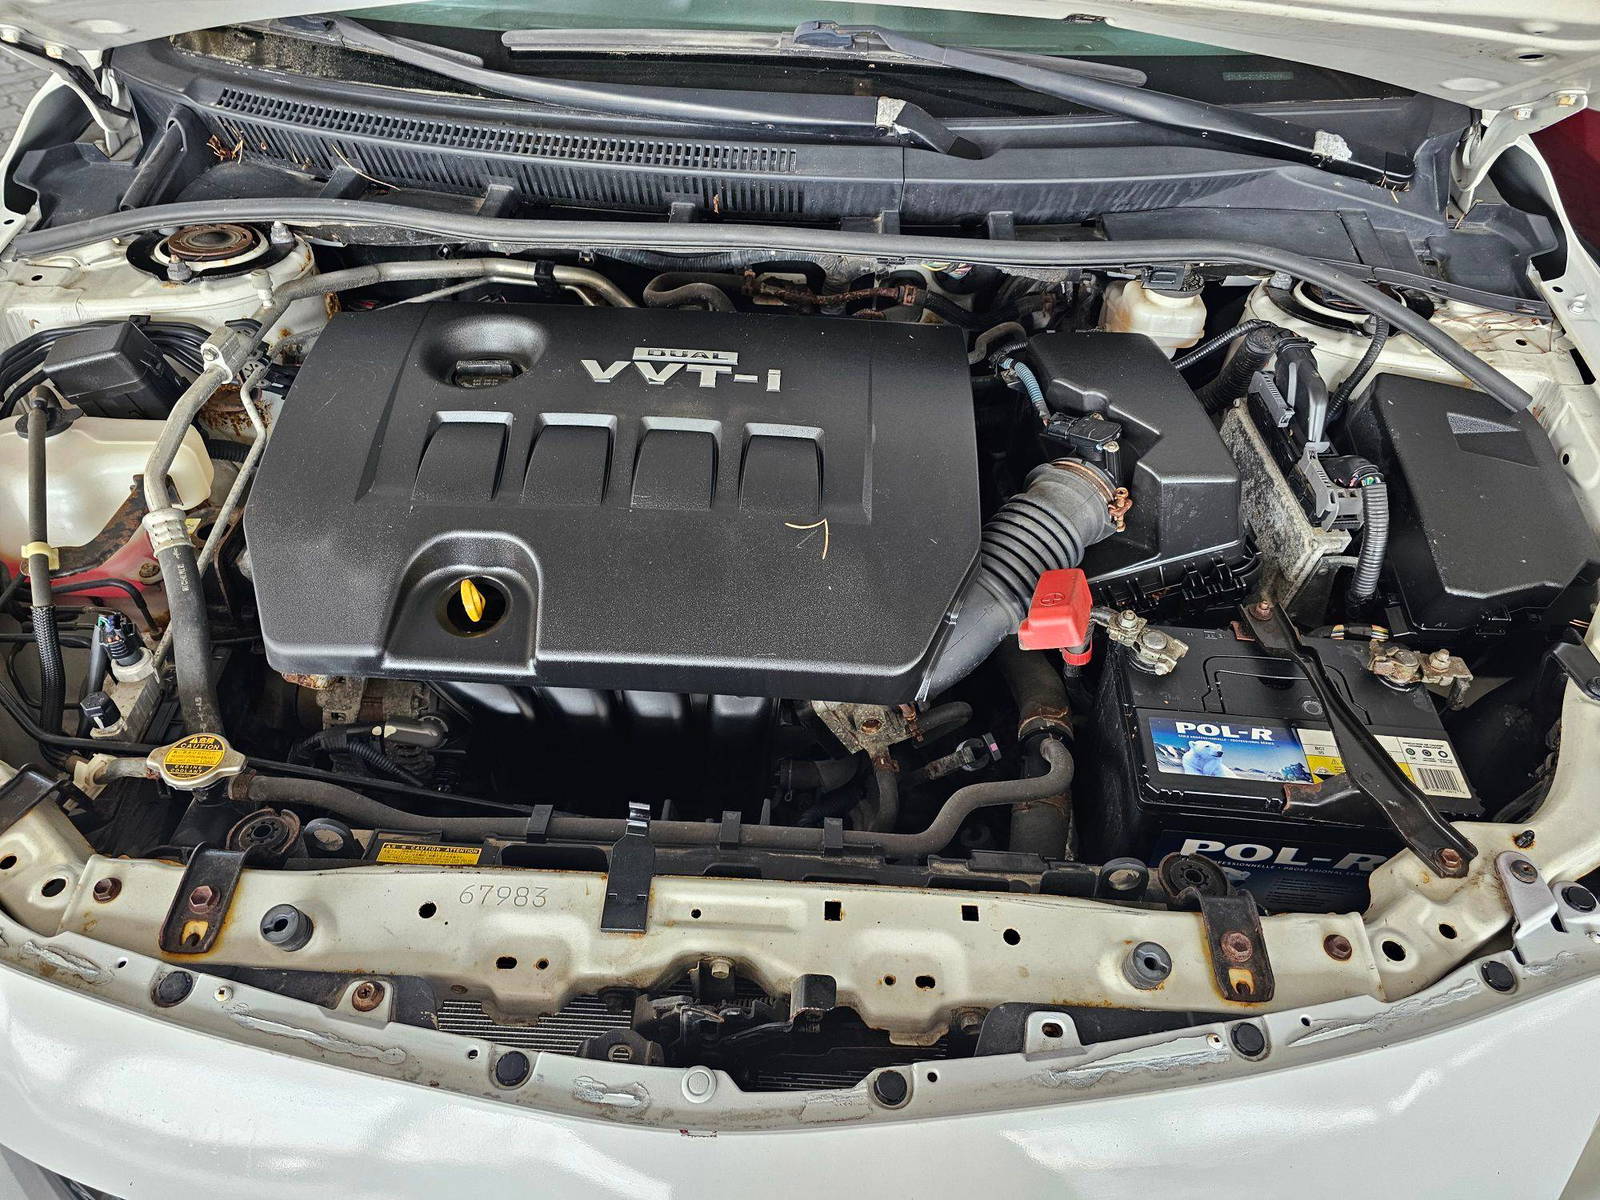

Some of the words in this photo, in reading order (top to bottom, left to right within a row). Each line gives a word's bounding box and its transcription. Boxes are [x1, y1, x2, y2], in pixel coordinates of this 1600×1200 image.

[648, 348, 728, 361] DUAL
[1175, 721, 1274, 741] POL-R
[180, 742, 220, 750] CAUTION
[1180, 838, 1388, 872] POL-R
[1216, 860, 1275, 870] FESSIONNELLE
[459, 884, 549, 908] 67983
